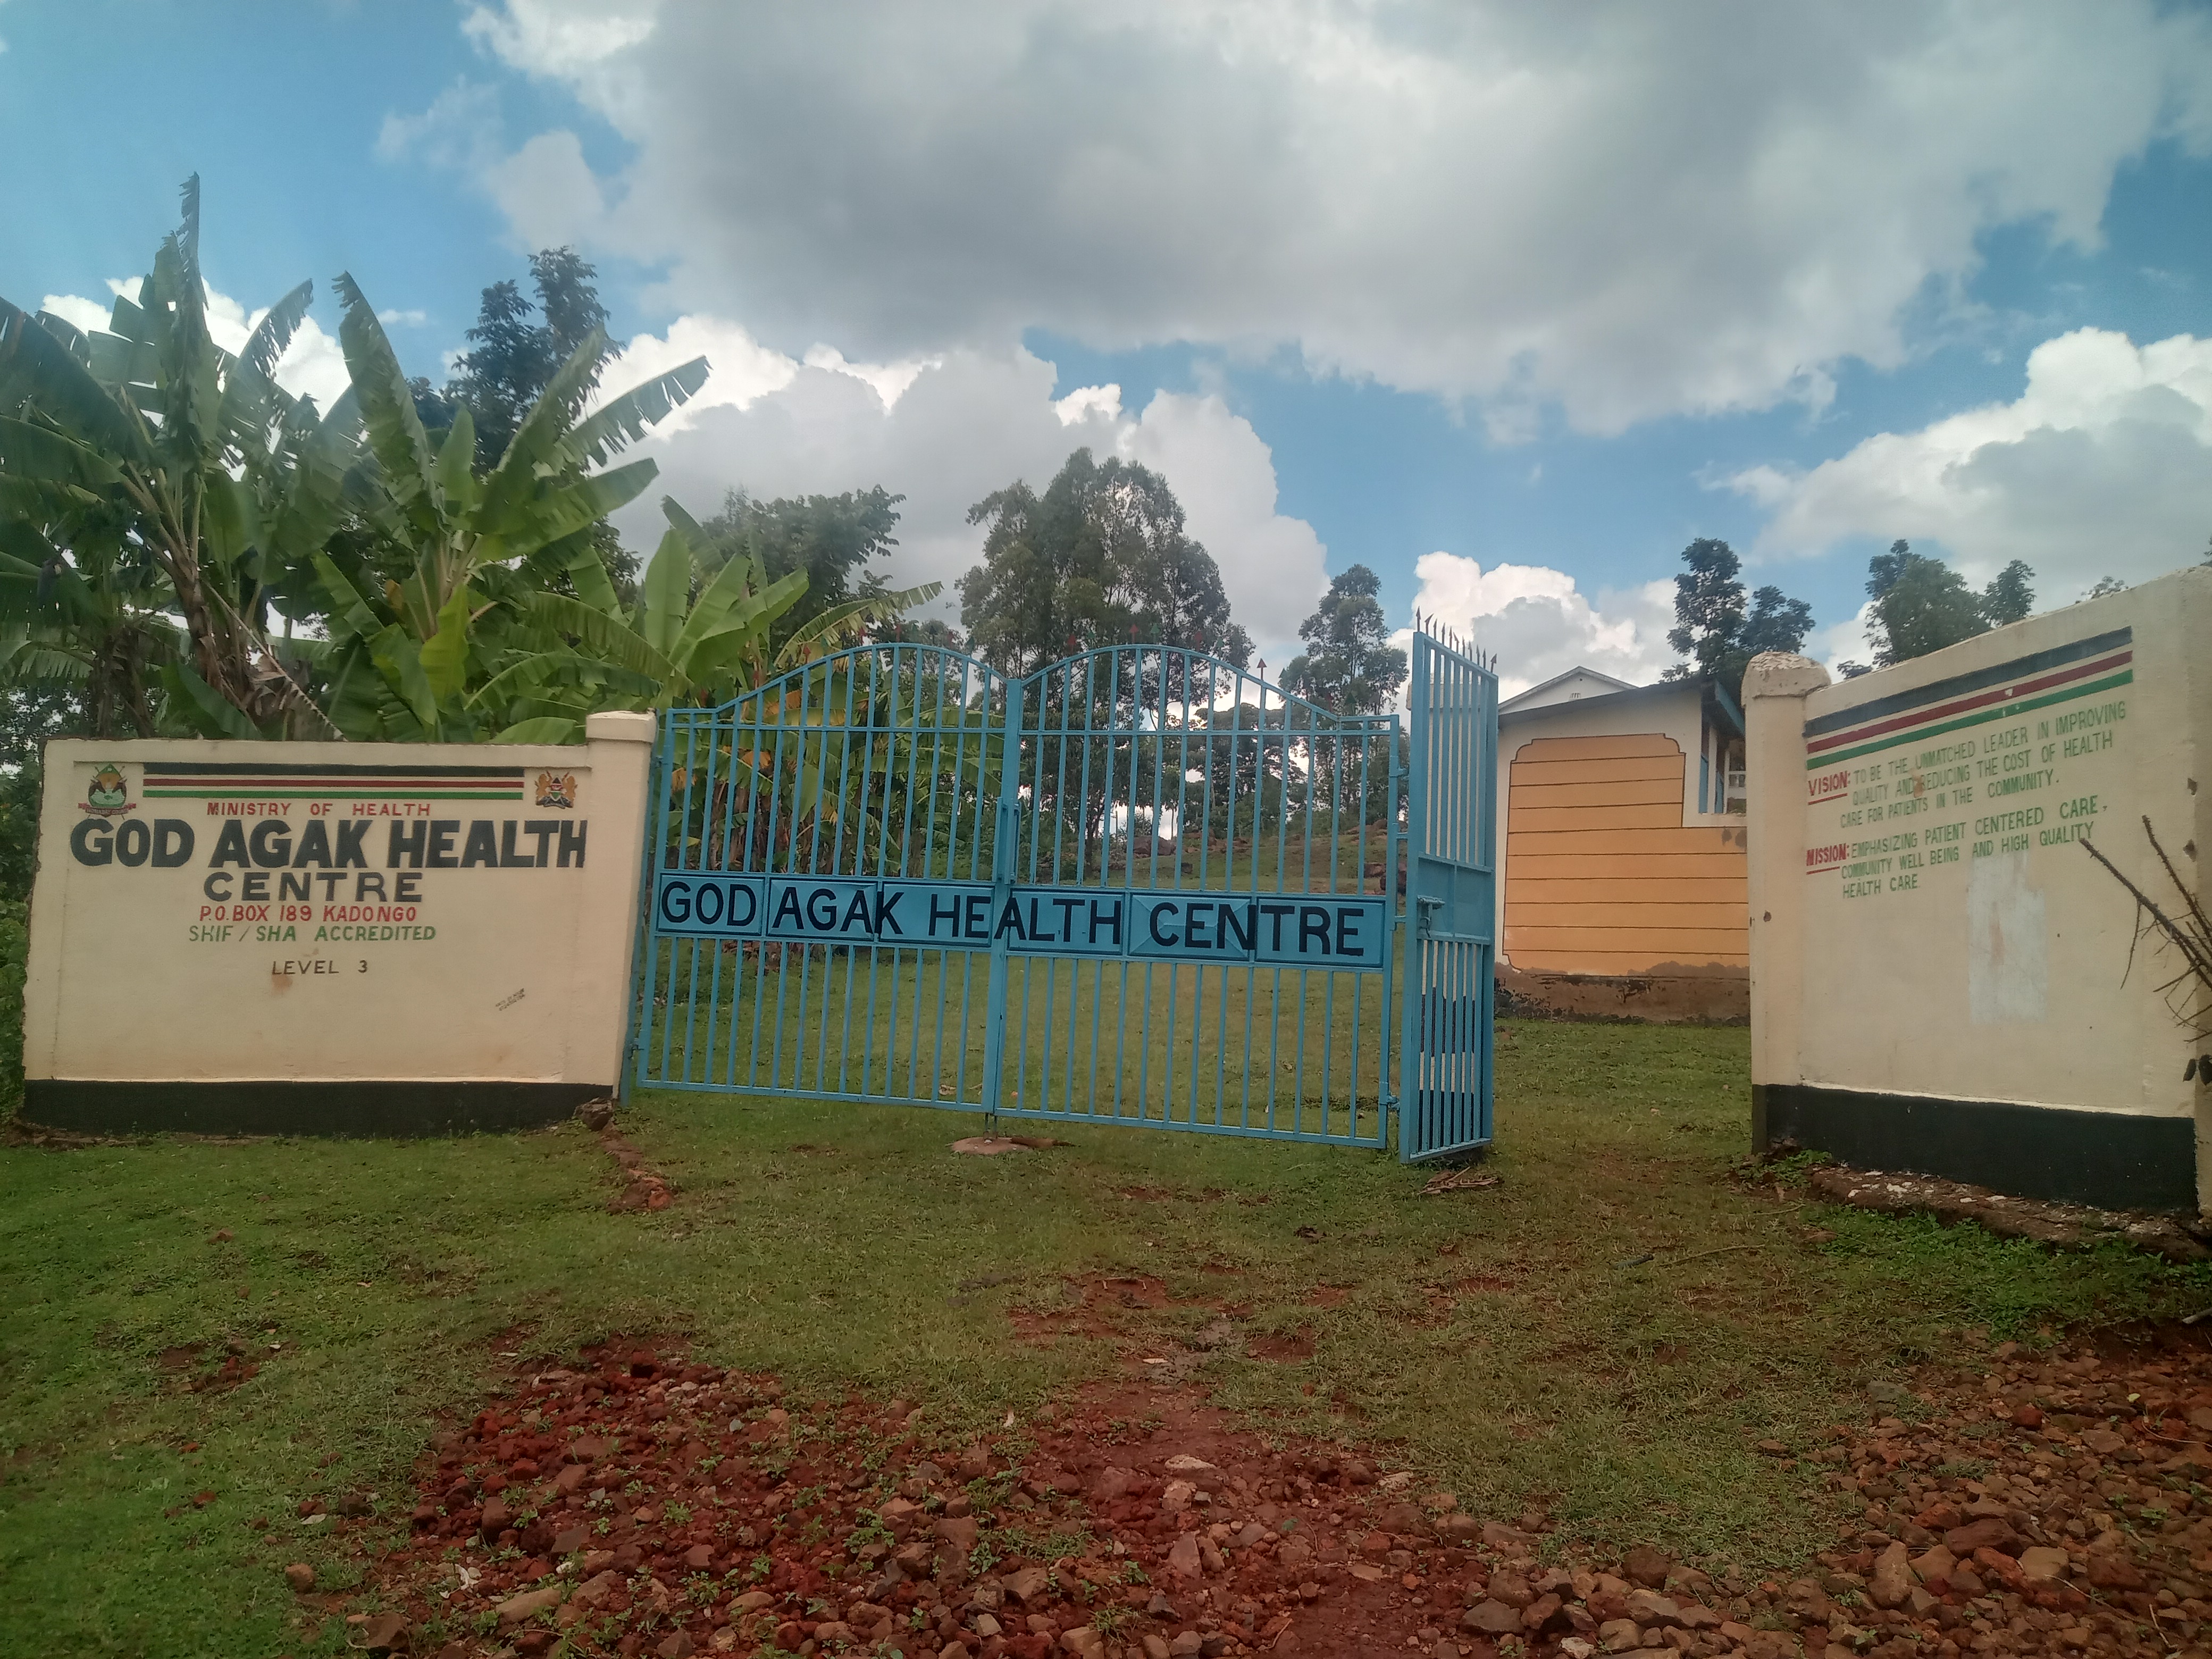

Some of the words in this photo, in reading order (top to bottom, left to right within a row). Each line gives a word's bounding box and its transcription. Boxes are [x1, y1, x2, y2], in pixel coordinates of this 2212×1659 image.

[1808, 770, 1850, 796] VISION:
[1853, 769, 1866, 784] TO
[1870, 765, 1882, 781] BE
[1888, 758, 1908, 776] THE
[1915, 741, 1975, 769] UNMATCHED
[1983, 727, 2028, 753] LEADER
[2038, 720, 2049, 740] IN
[2056, 701, 2126, 735] IMPROVING
[1853, 784, 1888, 806] QUALITY
[1895, 777, 1914, 797] AND
[1921, 765, 1970, 790] REDUCING
[1977, 757, 1998, 778] THE
[2004, 749, 2031, 772] COST
[2041, 743, 2056, 763] OF
[2064, 730, 2113, 758] HEALTH
[207, 802, 291, 816] MINISTRY
[310, 802, 333, 816] OF
[353, 803, 431, 816] HEALTH
[1840, 810, 1862, 828] CARE
[1867, 807, 1883, 824] FOR
[1888, 798, 1928, 819] PATIENTS
[1936, 793, 1946, 809] IN
[1953, 786, 1973, 806] THE
[1988, 769, 2059, 798] COMMUNITY.
[70, 818, 195, 868] GOD
[208, 819, 373, 868] AGAK
[386, 820, 588, 868] HEALTH
[1806, 843, 1849, 866] MISSION:
[1851, 832, 1917, 858] EMPHASIZING
[1925, 822, 1966, 845] PATIENT
[1975, 807, 2044, 835] CENTERED
[1841, 858, 1892, 879] COMMUNITY
[1899, 852, 1924, 870] WELL
[1930, 846, 1959, 865] BEING
[1972, 840, 1994, 858] AND
[2001, 833, 2029, 853] HIGH
[2040, 821, 2094, 846] QUALITY
[203, 872, 423, 902] CENTRE
[1843, 879, 1881, 899] HEALTH
[279, 906, 312, 921] 189
[323, 906, 417, 922] KADONGO
[314, 925, 436, 941] ACCREDITED
[661, 881, 757, 927] GOD
[772, 886, 904, 935] AGAK
[928, 894, 1121, 945] HEALTH
[1149, 902, 1364, 956] CENTRE
[272, 960, 339, 975] LEVEL
[358, 960, 368, 973] 3
